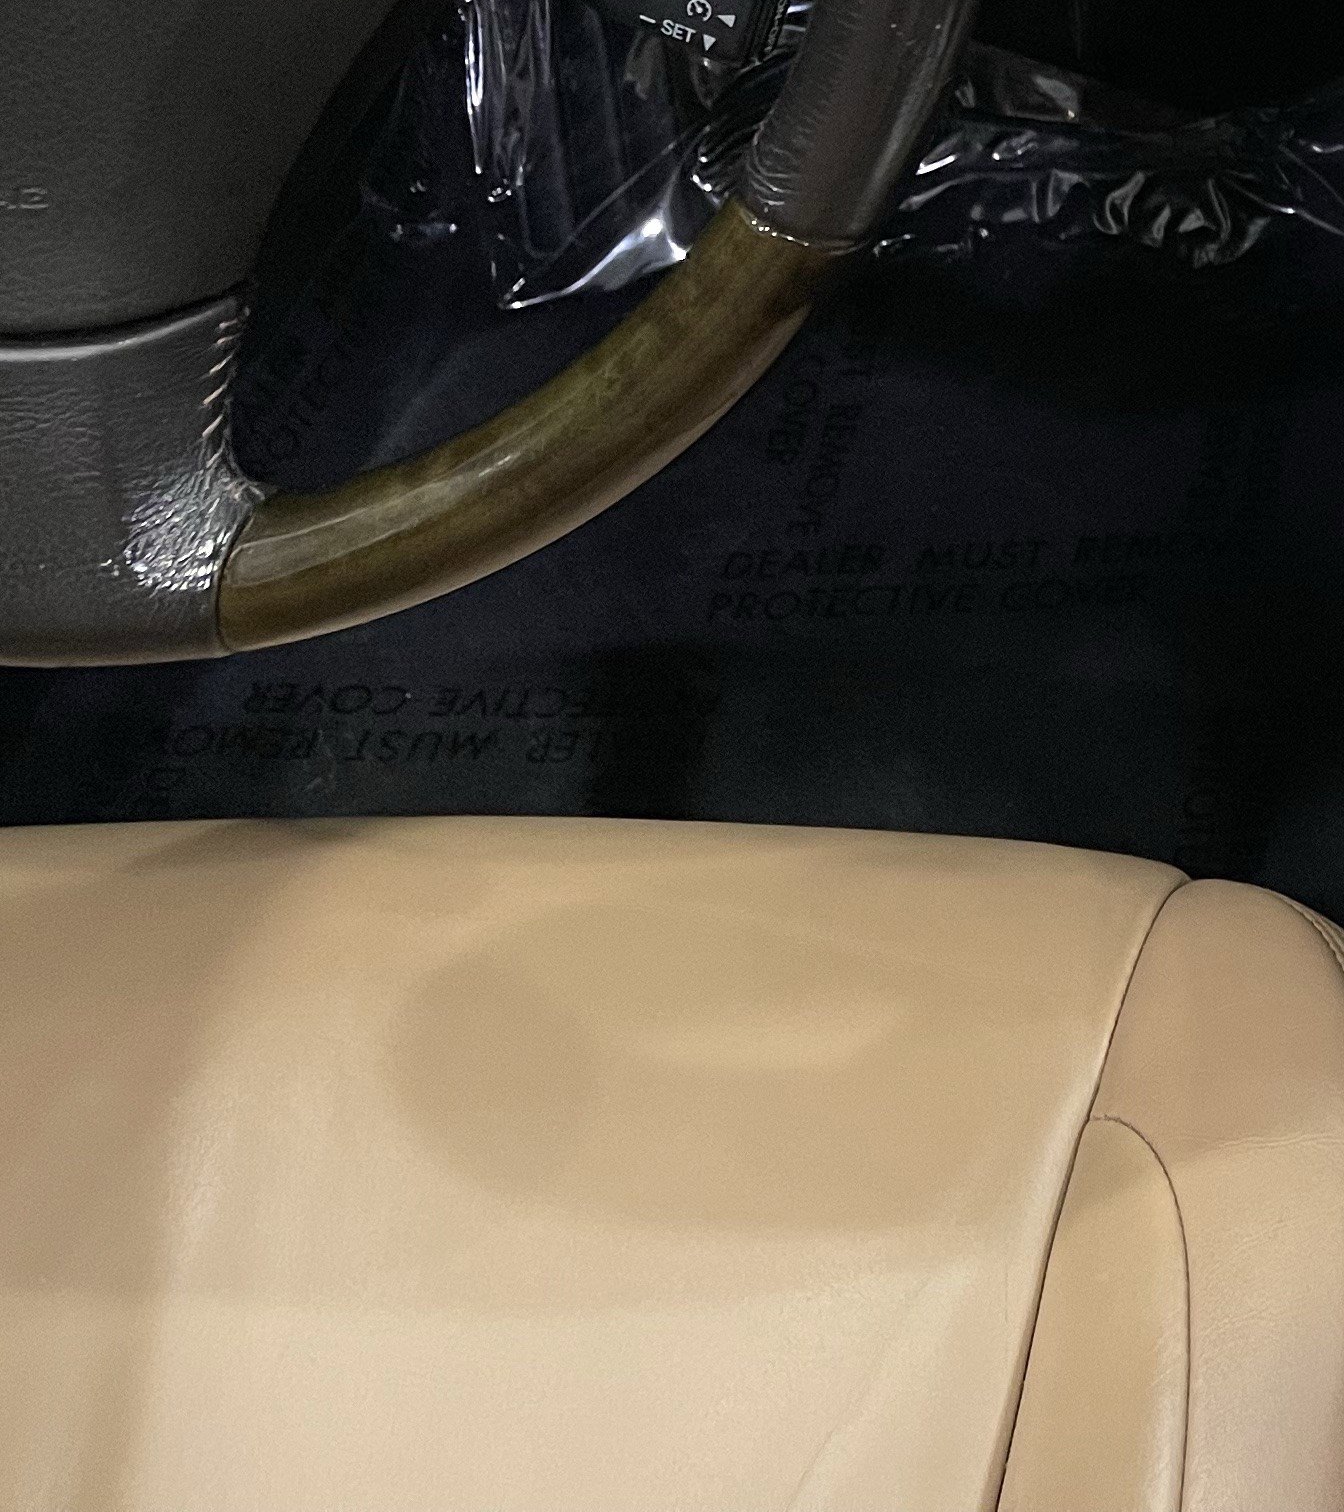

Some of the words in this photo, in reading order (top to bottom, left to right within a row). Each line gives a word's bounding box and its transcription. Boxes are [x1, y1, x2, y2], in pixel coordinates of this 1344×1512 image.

[661, 19, 697, 43] SET
[720, 544, 887, 581] DEALER
[916, 537, 1049, 571] MUST
[707, 580, 980, 623] PROTECTIVE
[243, 681, 407, 718] COVER
[345, 727, 499, 765] MUST
